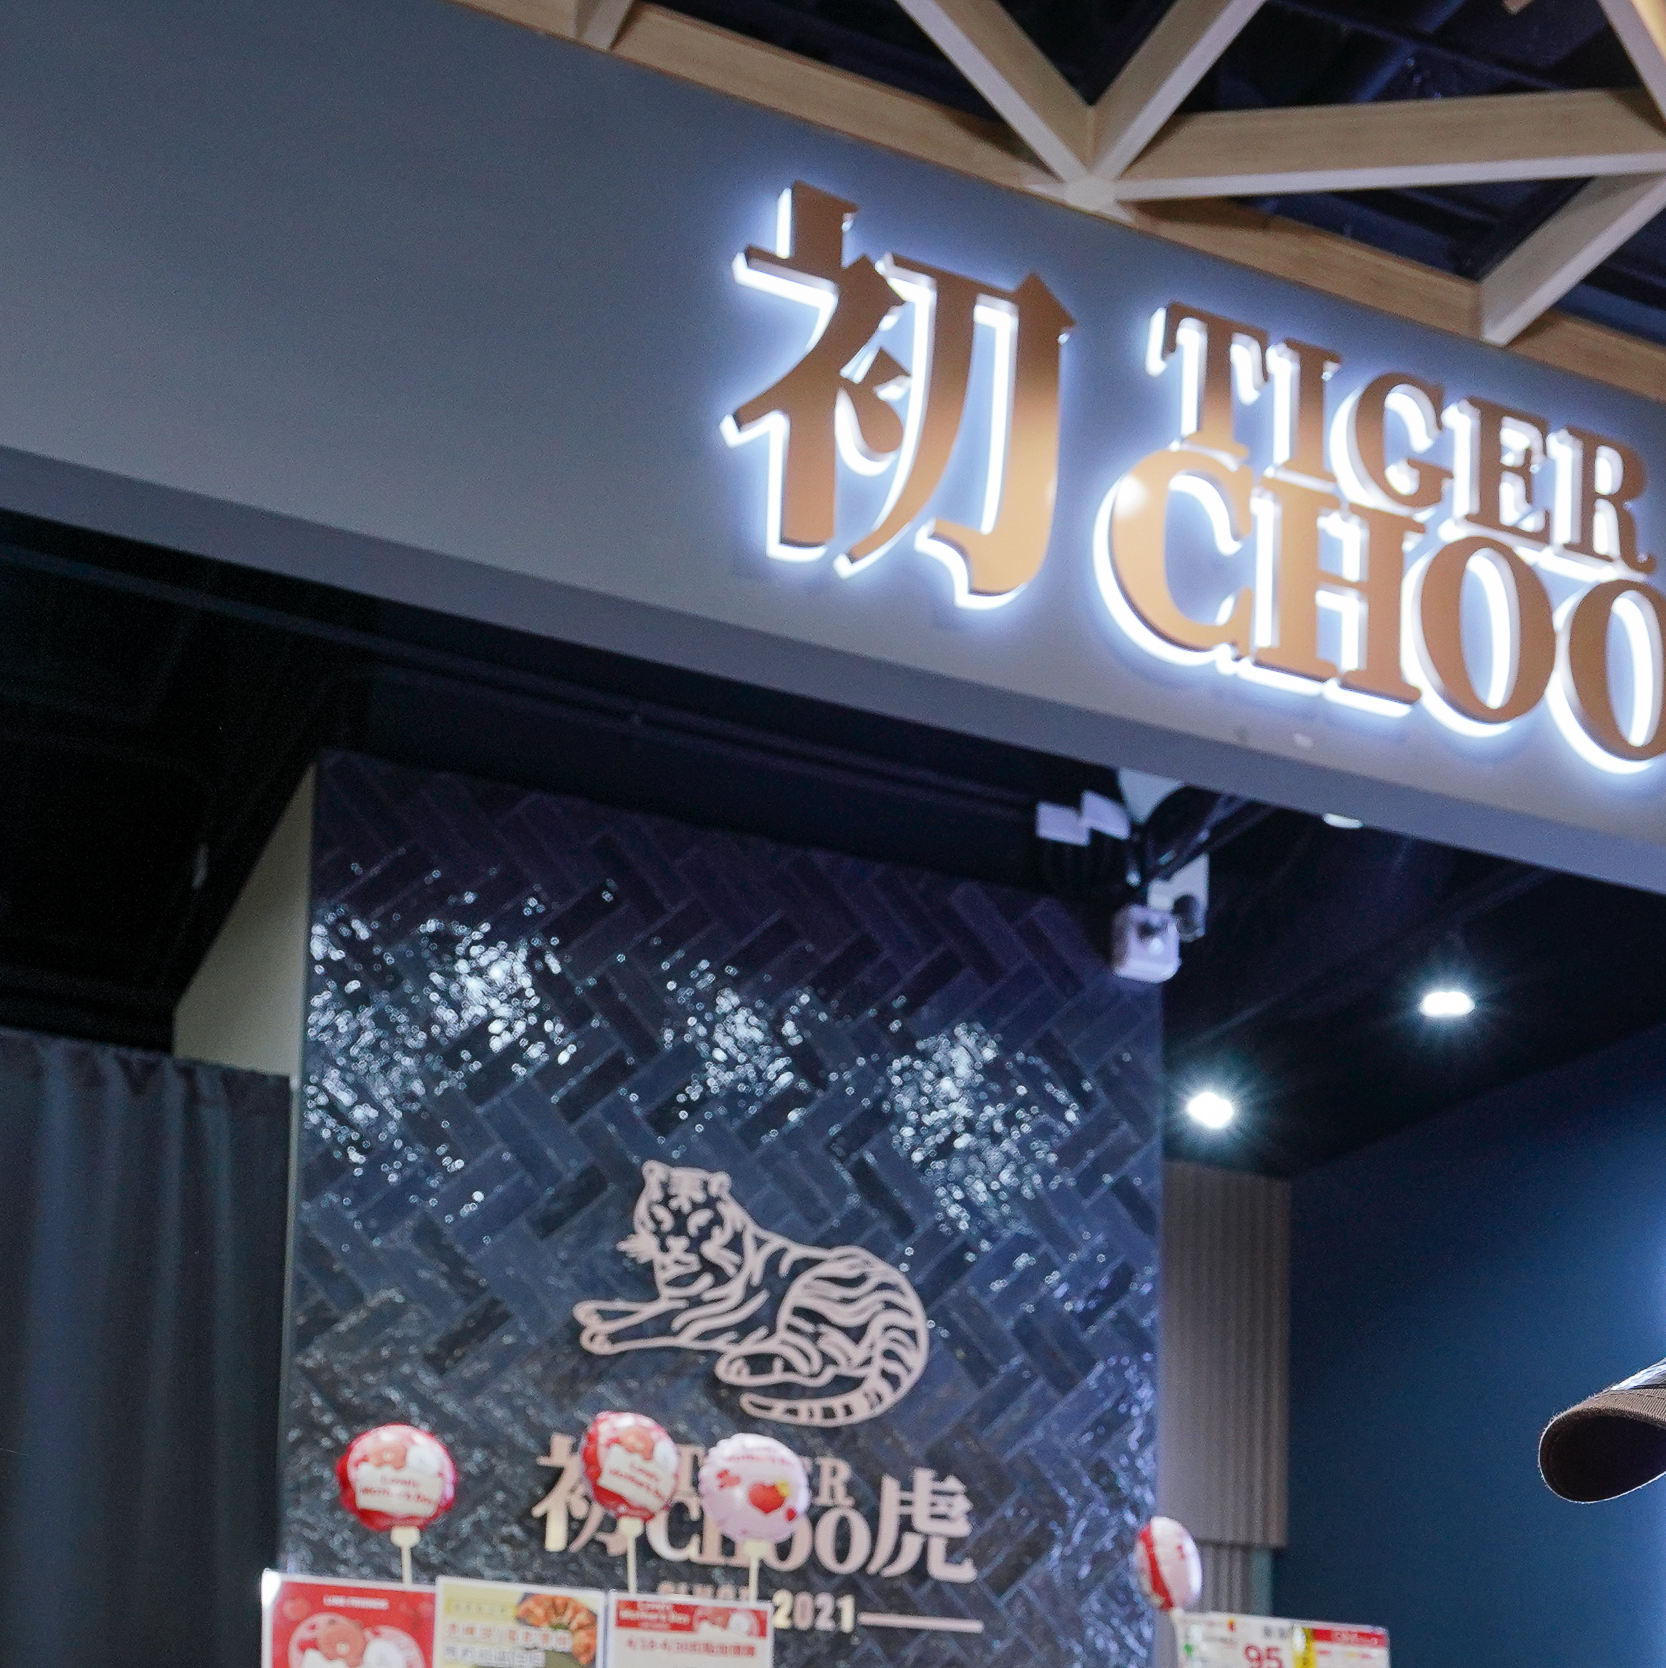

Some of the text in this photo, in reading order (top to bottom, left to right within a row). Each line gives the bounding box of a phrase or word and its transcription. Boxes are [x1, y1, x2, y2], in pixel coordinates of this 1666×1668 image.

[723, 182, 1075, 606] 初
[1147, 303, 1655, 580] TIGER
[773, 1588, 856, 1633] 2021
[867, 1467, 977, 1582] 虎
